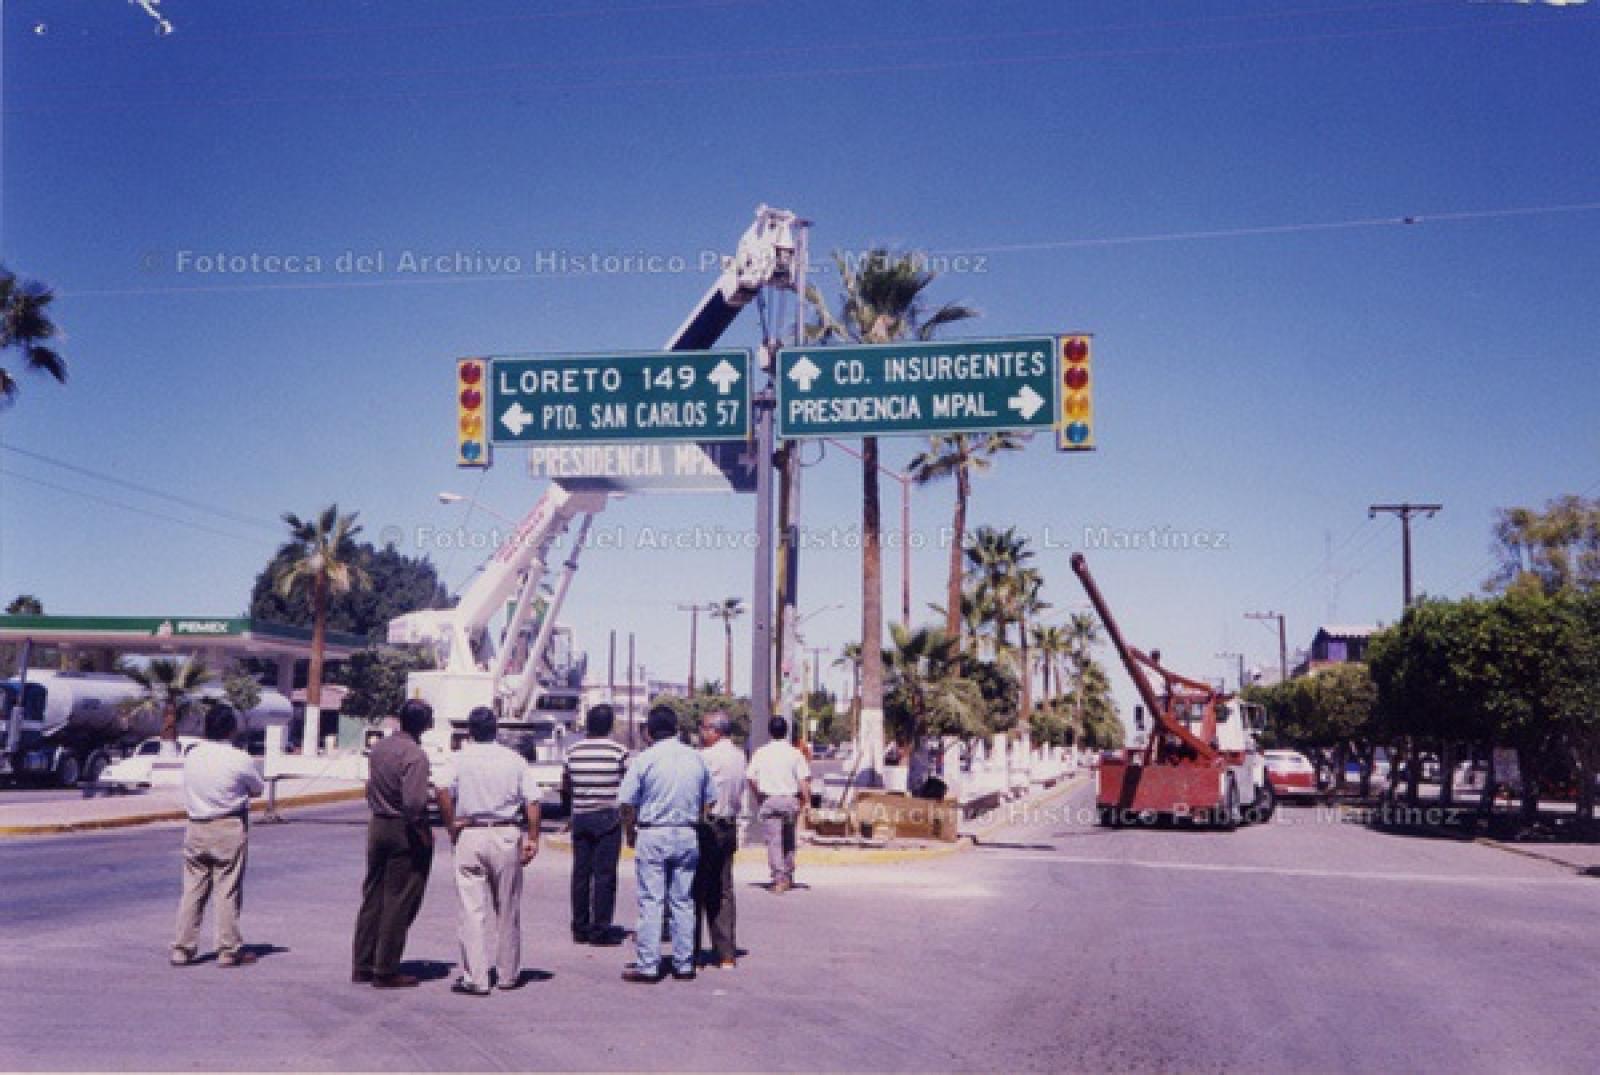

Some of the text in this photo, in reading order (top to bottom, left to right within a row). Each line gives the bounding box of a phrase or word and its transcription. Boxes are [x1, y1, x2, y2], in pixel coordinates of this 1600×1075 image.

[501, 364, 696, 394] LORETO 149
[834, 351, 1045, 384] CD. INSURGENTES
[543, 399, 740, 430] PTO. SAN CARLOS 57
[788, 394, 921, 424] PRESIDENCIA
[531, 443, 663, 477] PRESIDENCIA
[178, 621, 228, 633] PEMEX
